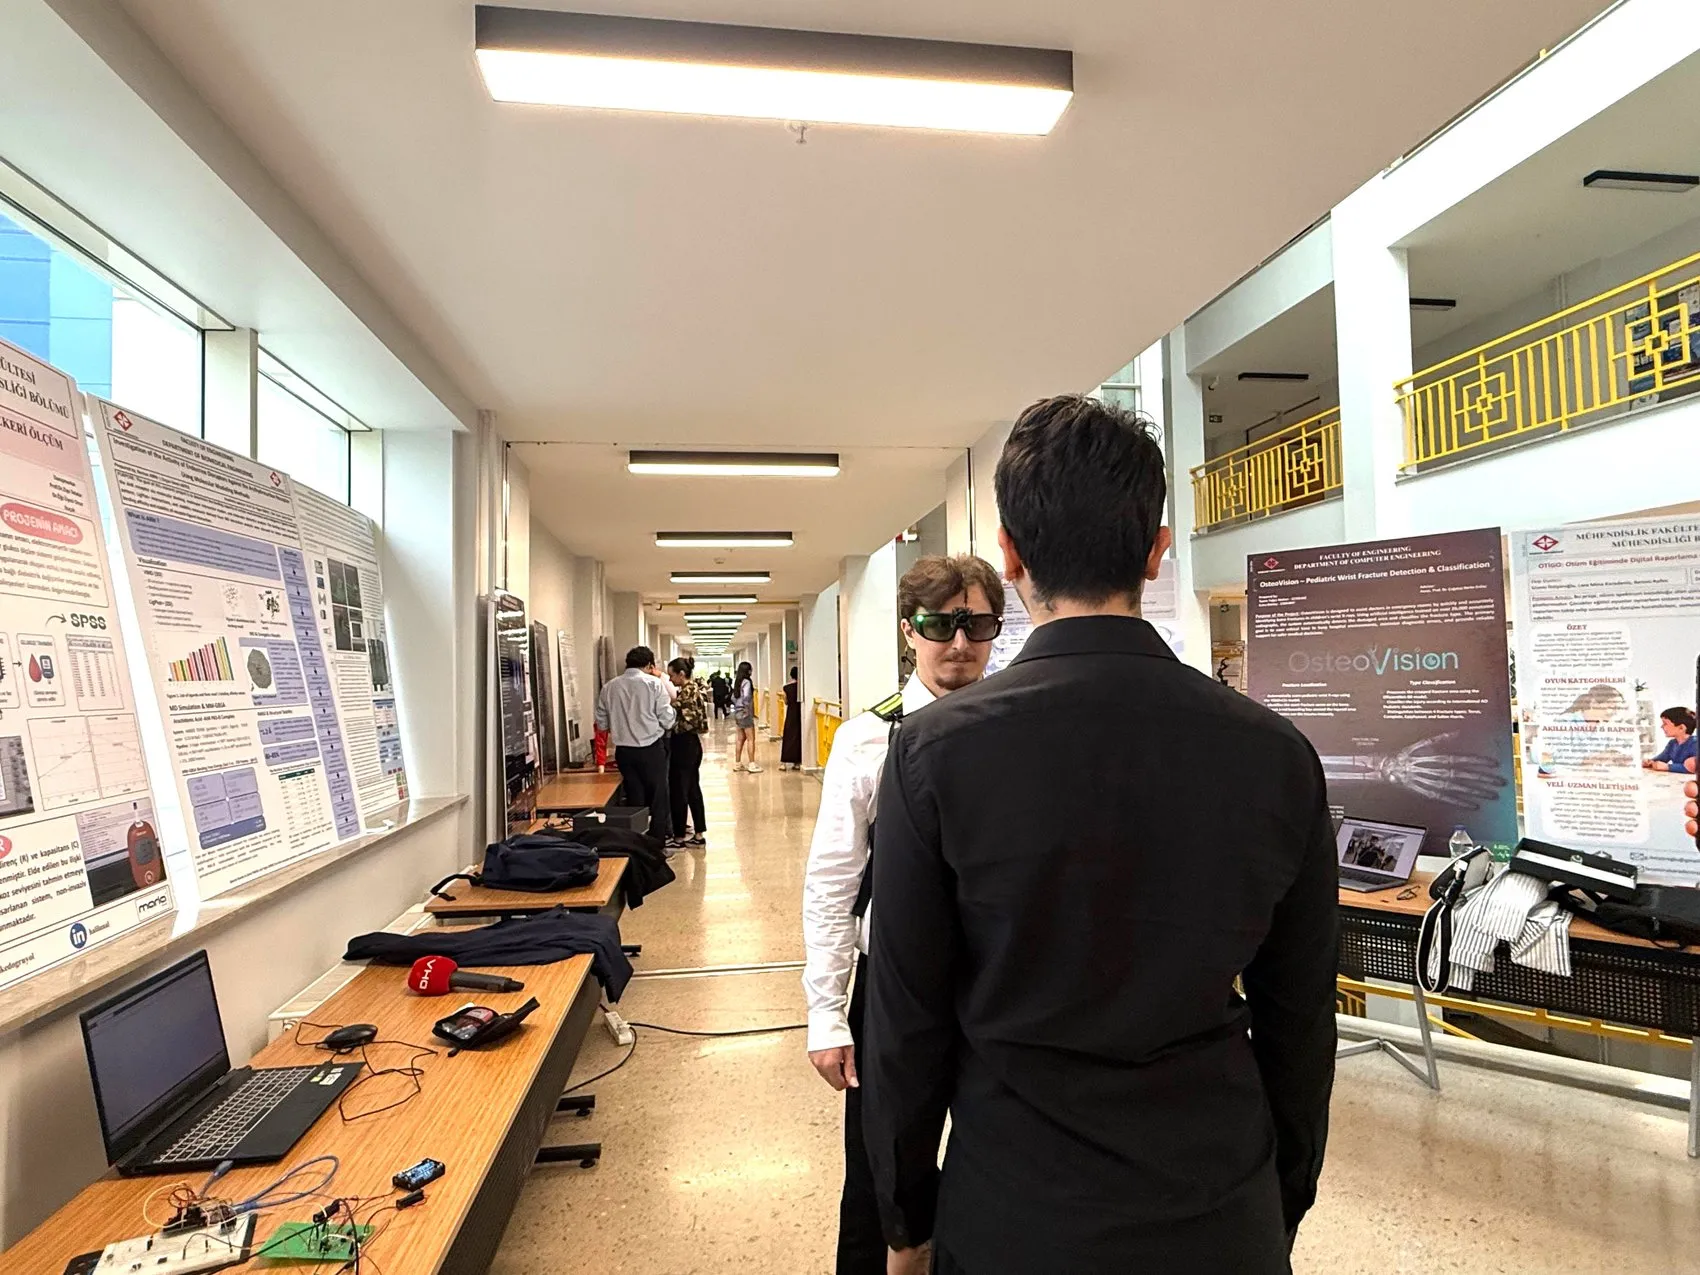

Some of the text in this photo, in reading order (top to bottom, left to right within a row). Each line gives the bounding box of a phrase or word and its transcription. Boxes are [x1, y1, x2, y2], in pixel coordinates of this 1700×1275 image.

[29, 390, 69, 419] BÖLÜMÜ
[0, 416, 64, 450] KERİ ÖLÇÜM
[3, 509, 78, 538] PROJENİN AMACI
[1576, 528, 1649, 540] MÜHENDİSLİK
[1612, 535, 1691, 547] MÜHENDİSLİĞİ
[1294, 560, 1338, 570] DEPARTMENT
[1350, 555, 1389, 565] COMPUTER
[1390, 550, 1441, 560] ENGINEERING
[1319, 551, 1350, 560] FACULTY
[1362, 546, 1411, 556] ENGINEERING
[1655, 554, 1697, 562] Raporlama
[1260, 578, 1299, 588] OsteoVision
[1306, 575, 1336, 584] Pediatric
[1337, 573, 1357, 581] Wrist
[1358, 570, 1388, 580] Fracture
[1390, 567, 1427, 577] Detection
[1437, 561, 1491, 573] Classification
[70, 613, 107, 630] SPSS
[1288, 645, 1458, 675] OsteoVision
[1568, 676, 1626, 684] KATEGORİLERİ
[1599, 782, 1639, 791] İLETİŞİMİ
[19, 854, 29, 864] (R)
[40, 844, 70, 857] kapasitans
[71, 840, 79, 850] (C)
[27, 867, 40, 876] Elde
[42, 861, 60, 871] edilen
[69, 854, 81, 863] ilişki
[12, 880, 41, 896] seviyesini
[42, 875, 63, 885] tahmin
[64, 868, 84, 879] etmeye
[31, 894, 53, 904] sistem,
[56, 881, 86, 896] non-invaziv
[72, 929, 85, 944] in
